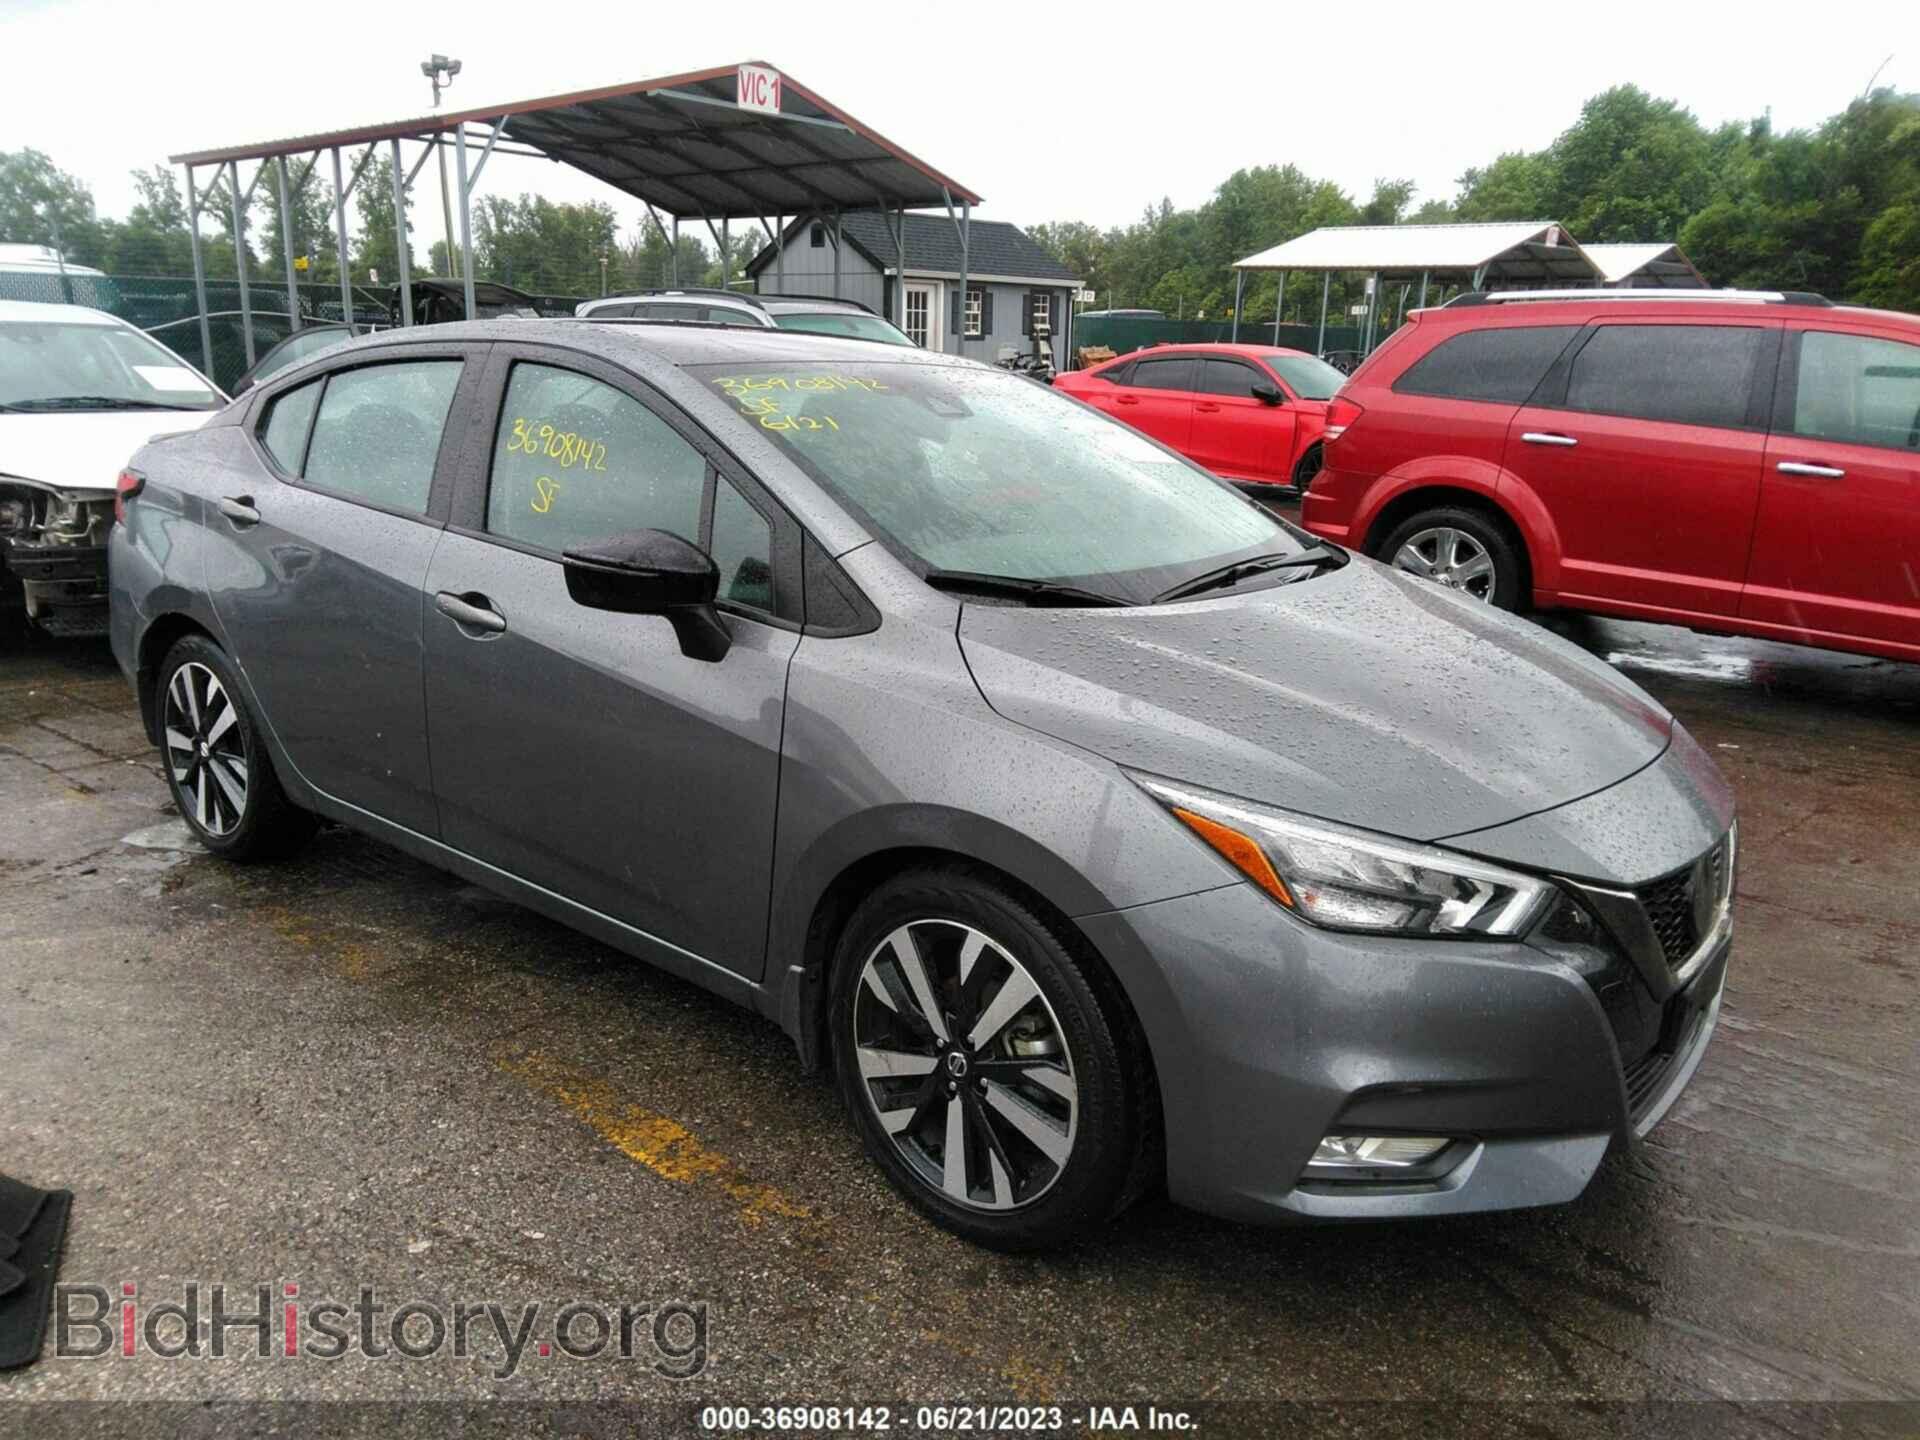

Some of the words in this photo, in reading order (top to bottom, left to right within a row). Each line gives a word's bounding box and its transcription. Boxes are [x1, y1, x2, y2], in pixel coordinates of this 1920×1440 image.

[740, 70, 768, 106] VIC
[771, 78, 779, 109] 1
[507, 418, 608, 472] 36908142
